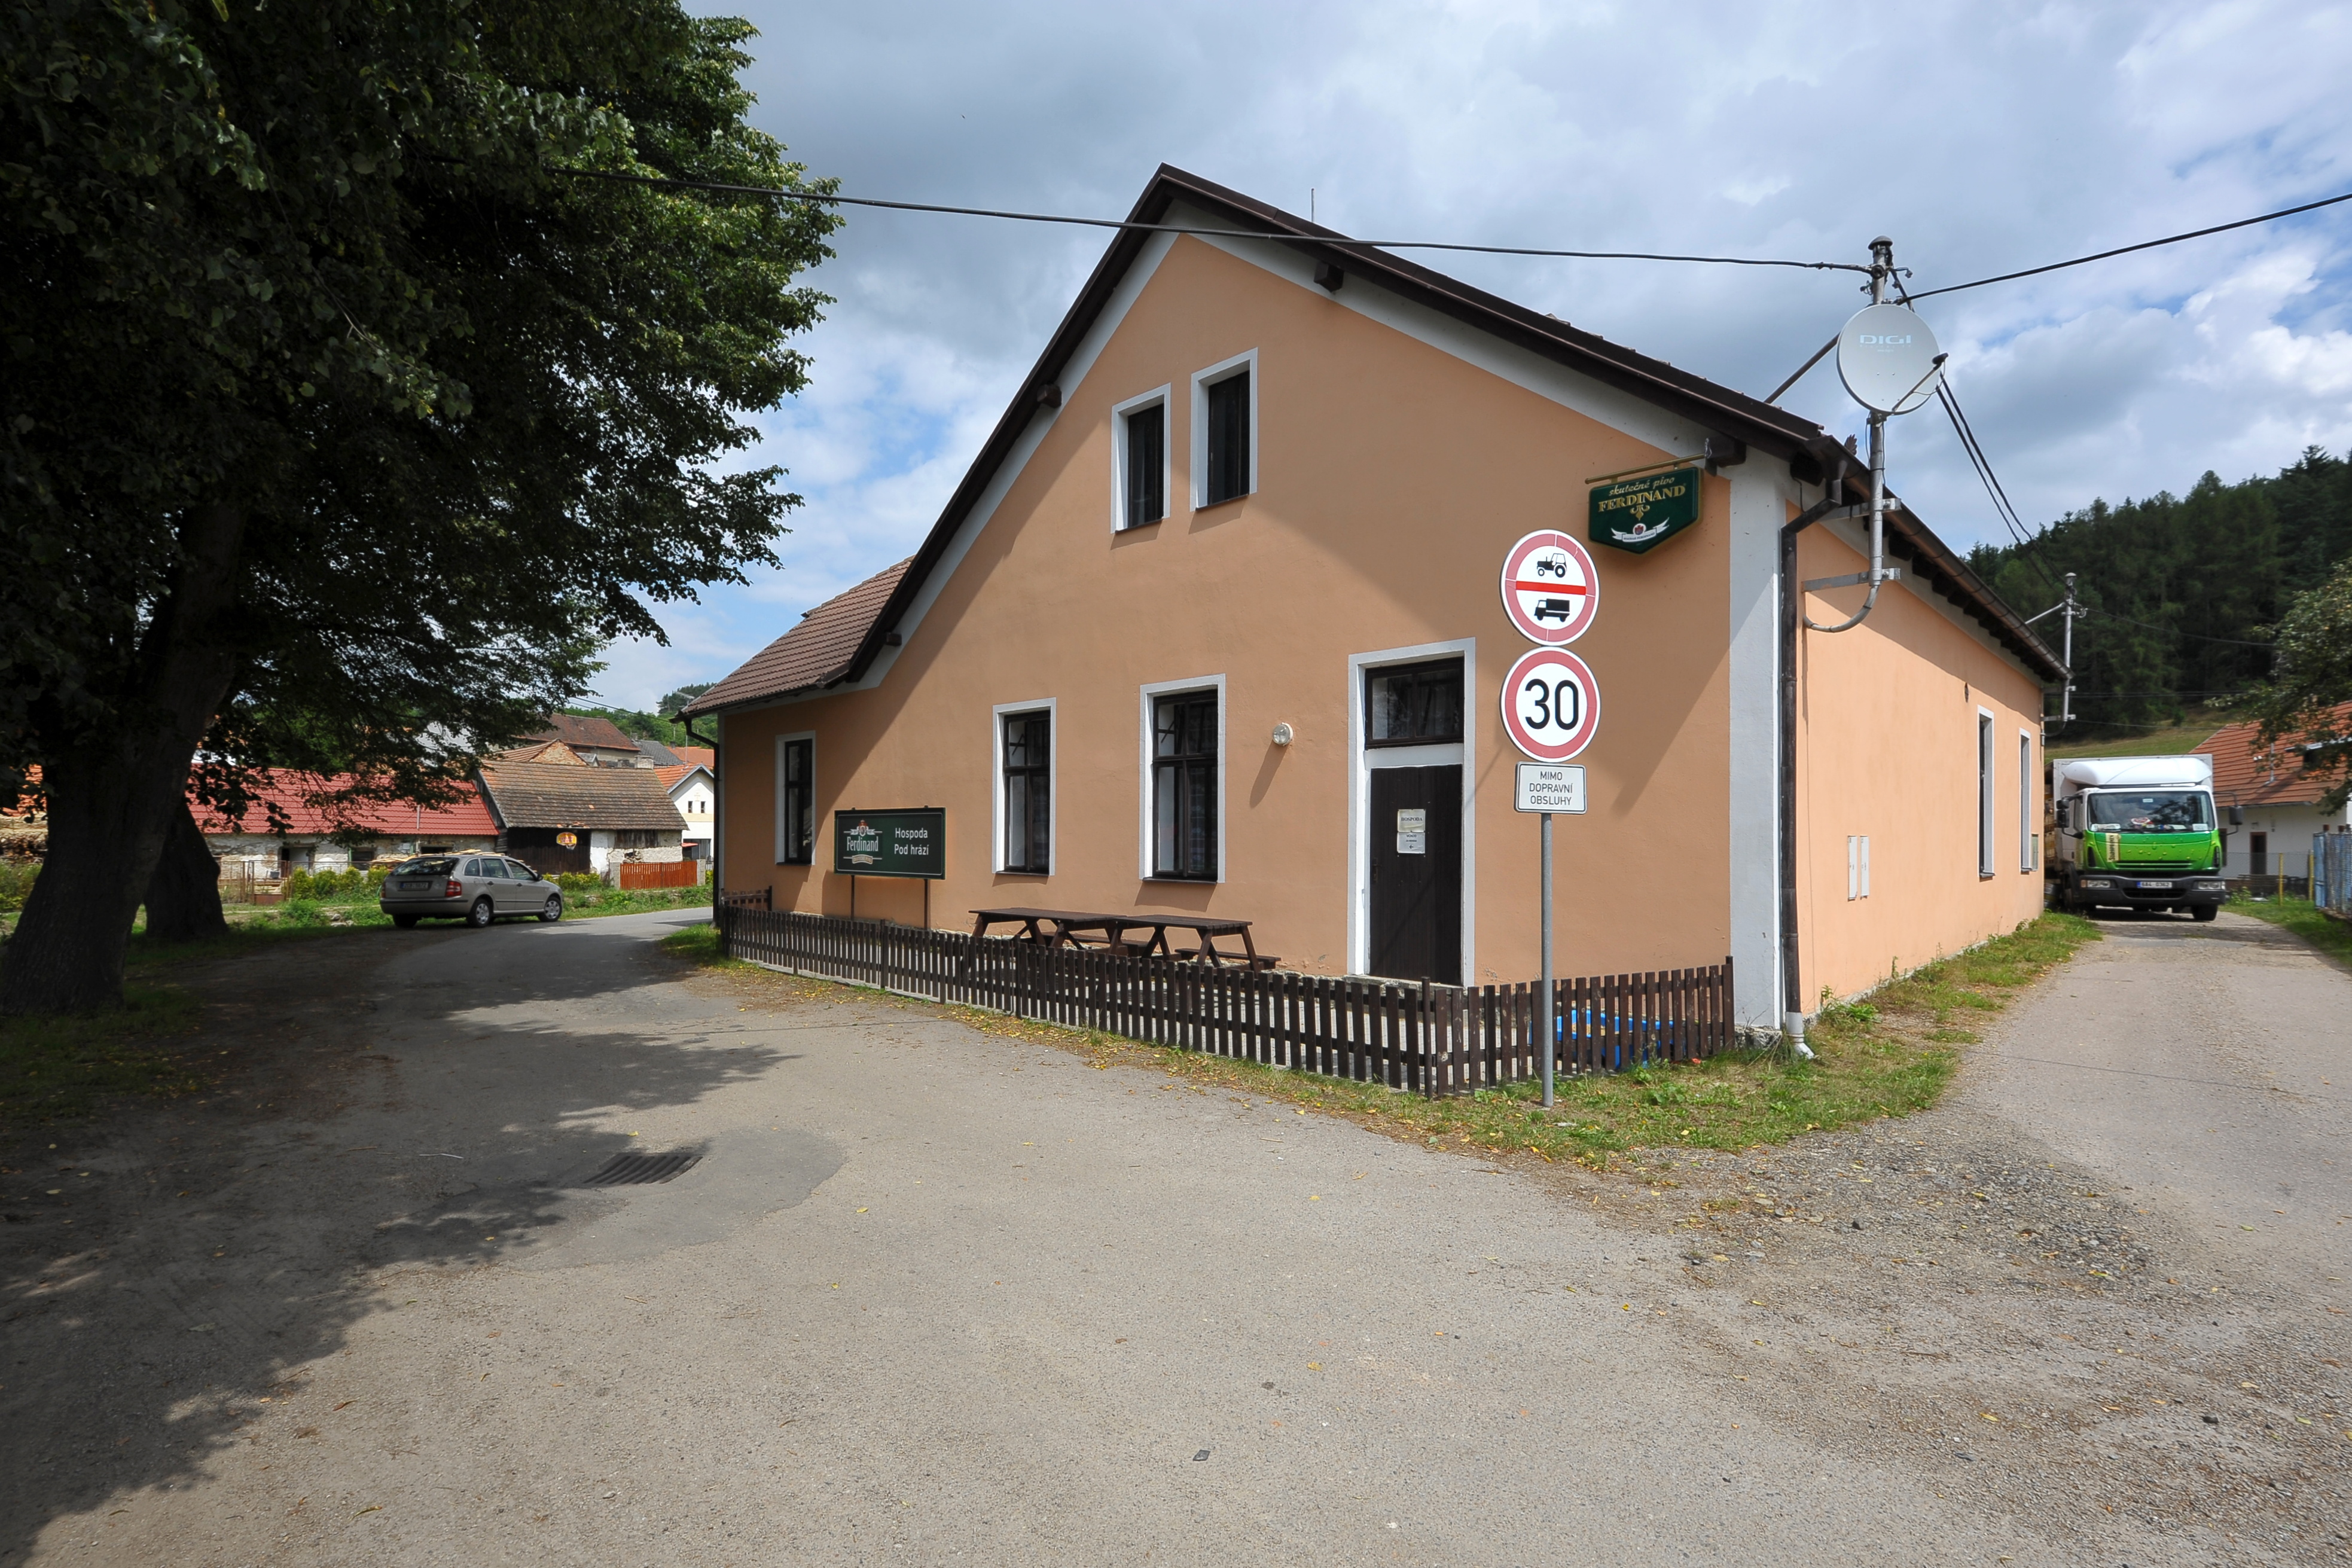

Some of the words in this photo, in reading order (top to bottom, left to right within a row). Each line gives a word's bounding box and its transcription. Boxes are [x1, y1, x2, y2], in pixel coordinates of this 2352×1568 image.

[1860, 334, 1911, 344] DIGI
[1652, 476, 1675, 489] pivo
[1598, 485, 1685, 513] FERDINAND
[1525, 678, 1579, 730] 30
[1540, 771, 1563, 780] MIMO
[1529, 783, 1573, 794] DOPRAVNÍ
[1530, 795, 1572, 806] OBSLUHY
[895, 828, 928, 840] Hospoda
[847, 836, 878, 852] Ferdinand
[894, 844, 908, 855] Pod
[910, 844, 929, 855] hrází
